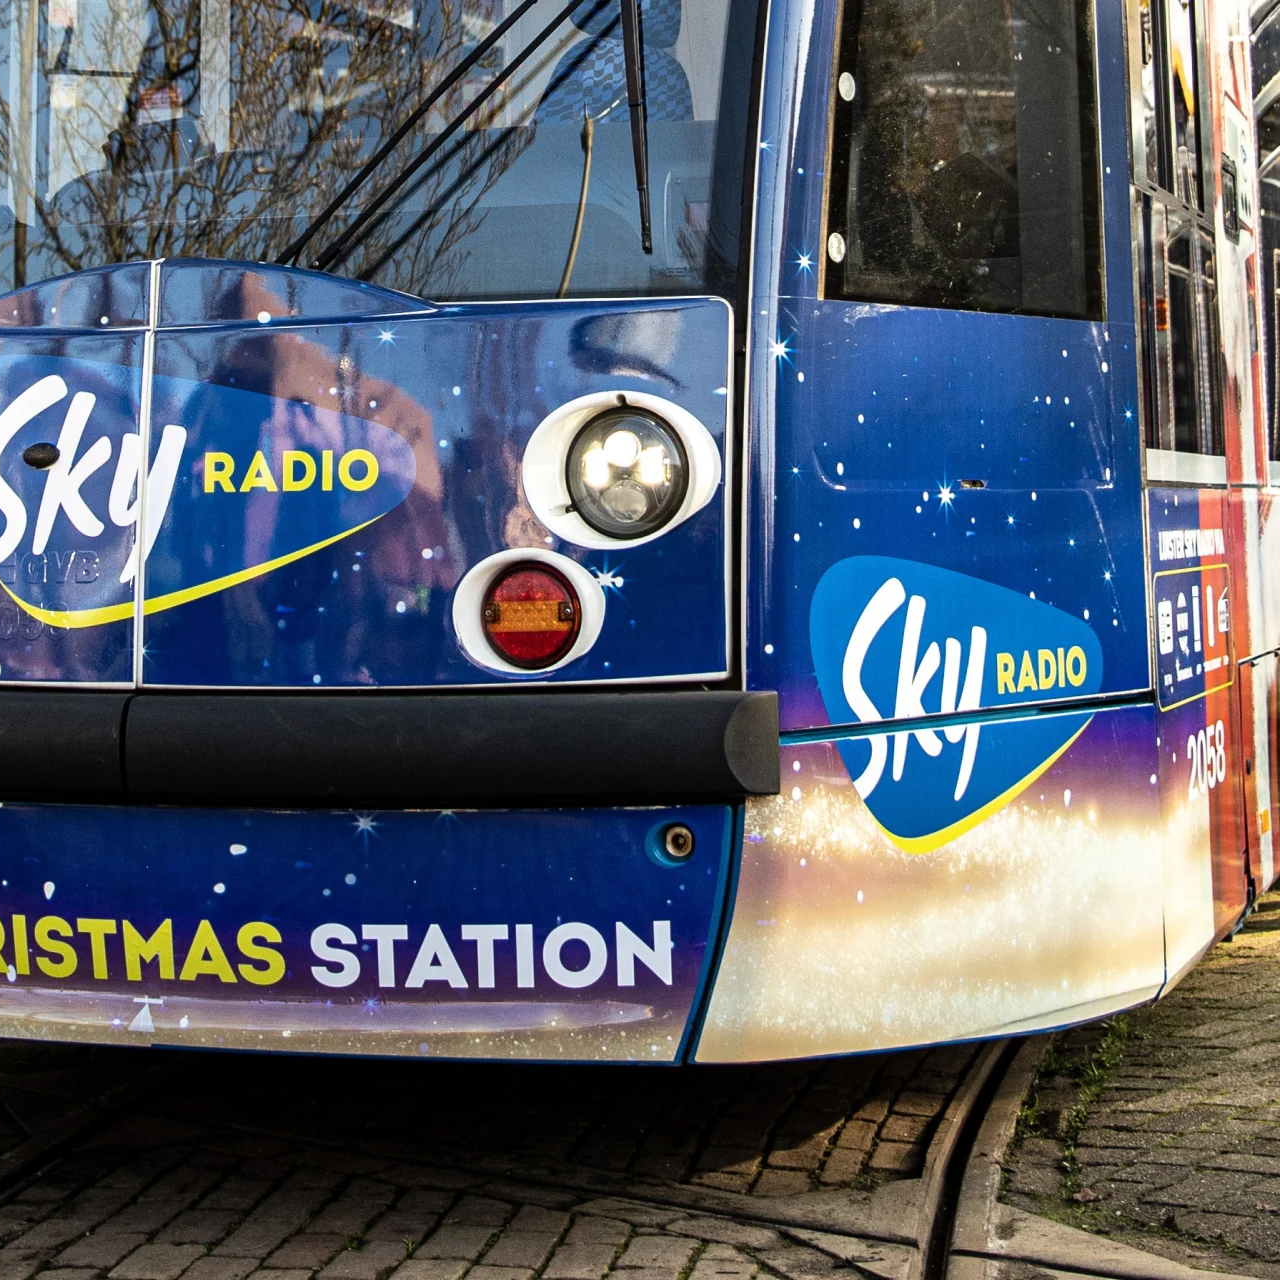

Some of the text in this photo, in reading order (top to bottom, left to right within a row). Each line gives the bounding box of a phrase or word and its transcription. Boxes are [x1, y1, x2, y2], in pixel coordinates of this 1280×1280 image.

[203, 449, 380, 494] RADIO
[841, 576, 1087, 801] Sky RADIO
[1186, 719, 1227, 799] 2058
[309, 919, 675, 988] STATION
